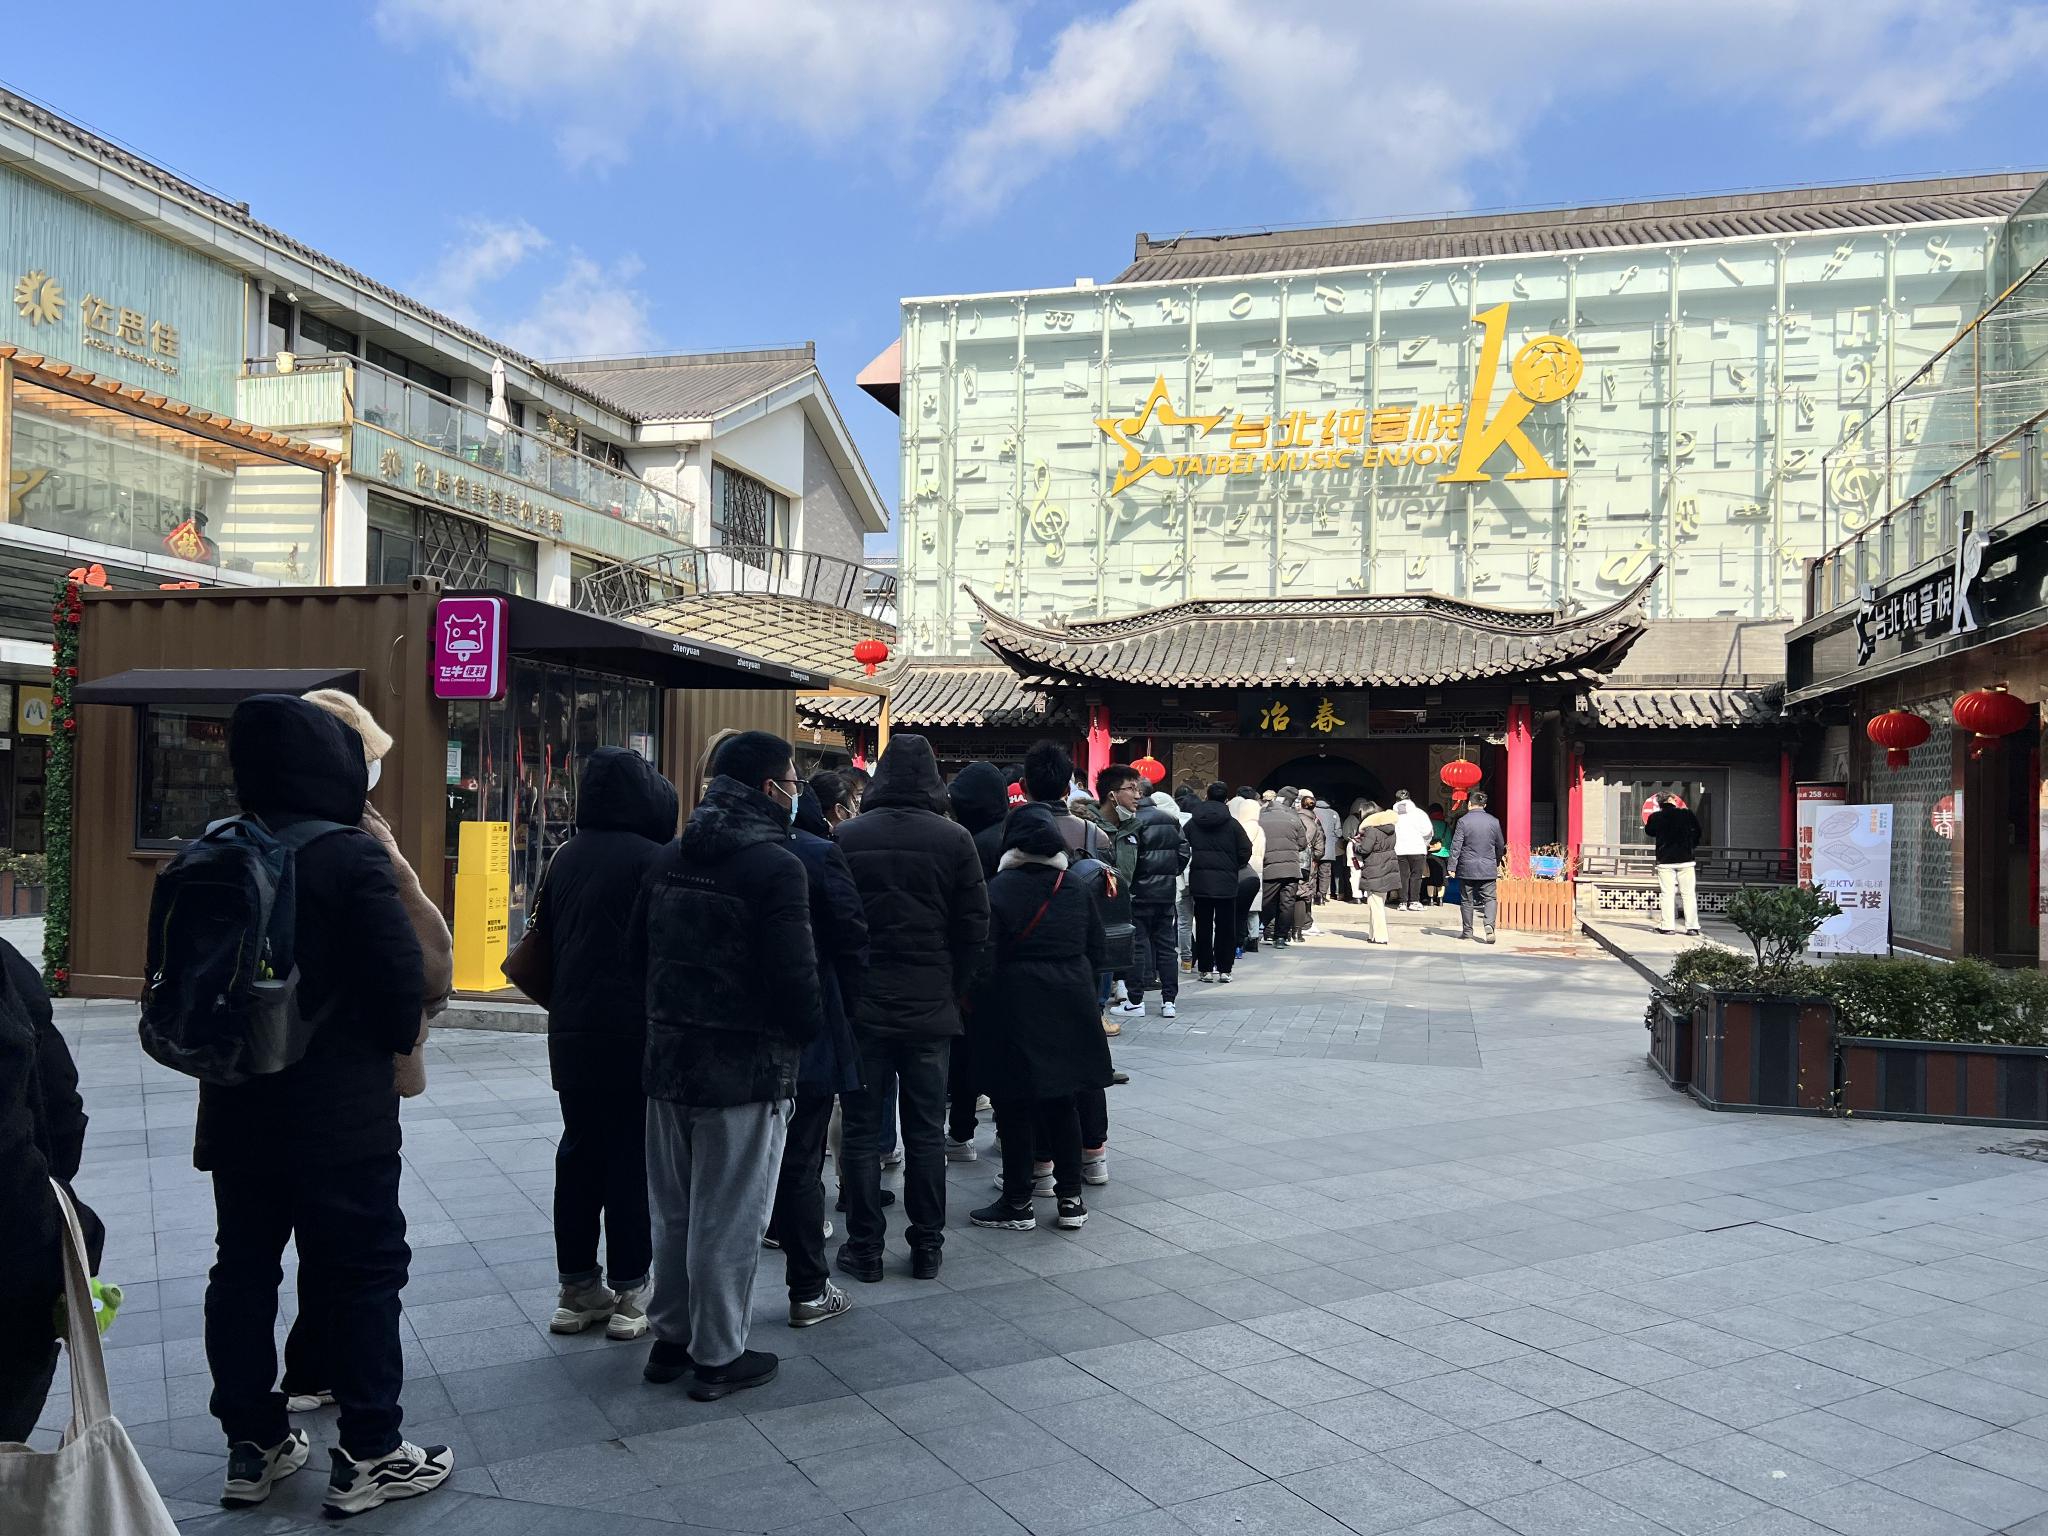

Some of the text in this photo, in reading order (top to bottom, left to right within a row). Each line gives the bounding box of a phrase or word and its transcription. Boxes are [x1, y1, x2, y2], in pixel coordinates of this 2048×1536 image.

[81, 293, 179, 358] 佐思佳
[1229, 404, 1463, 450] 台北纯音悦
[1173, 444, 1458, 476] TAIBEI MUSIC ENJOY
[1875, 576, 1953, 641] 台北纯音悦
[672, 643, 700, 657] zhenyuan
[737, 658, 761, 670] zhenyuan
[440, 665, 488, 678] 飞牛便利
[790, 670, 810, 682] zhenyuan
[1260, 698, 1346, 733] 冶春
